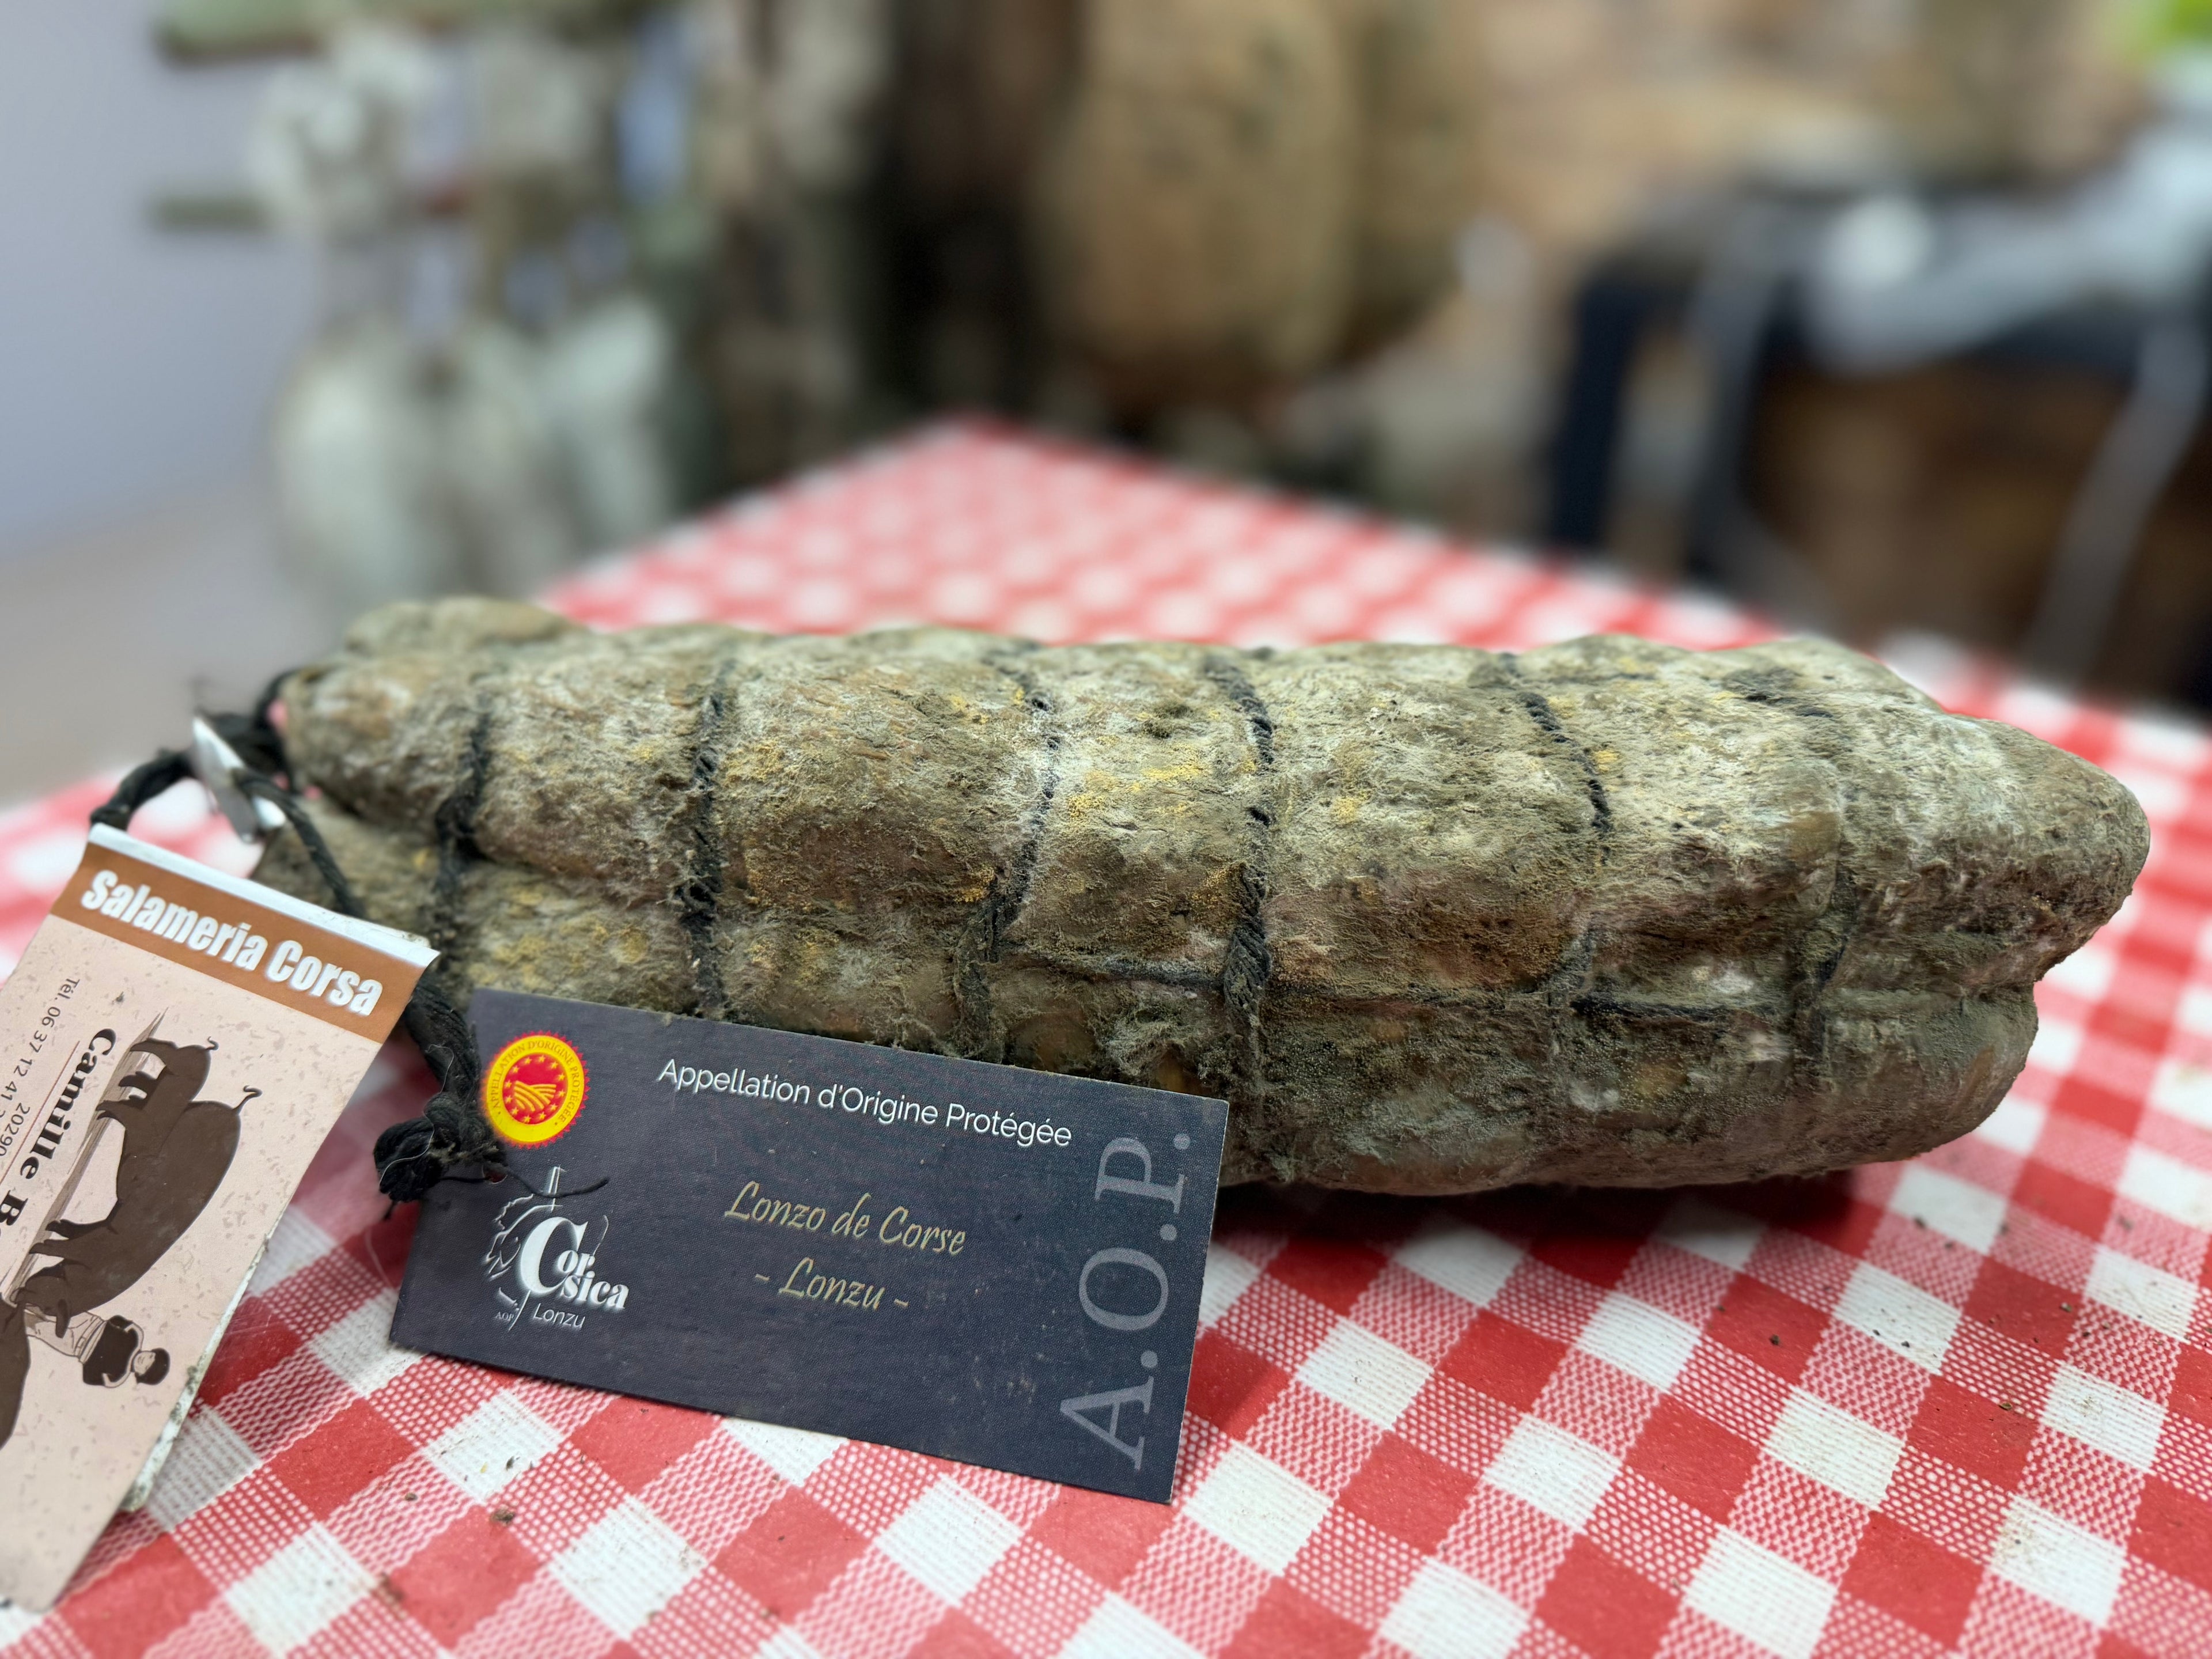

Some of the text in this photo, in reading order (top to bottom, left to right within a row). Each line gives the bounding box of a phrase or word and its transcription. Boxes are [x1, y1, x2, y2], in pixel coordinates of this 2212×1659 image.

[80, 869, 383, 1016] Salameria Corsa
[1, 978, 80, 1100] Tél. 06 37 12 41
[491, 1044, 525, 1109] APPELLATION
[528, 1040, 574, 1065] D'ORIGINE
[0, 1028, 116, 1237] Camille B
[657, 1059, 1071, 1147] Appellation d'Origine Protégée
[724, 1181, 966, 1255] Lonzo de Corse
[495, 1311, 514, 1321] AOP
[533, 1303, 586, 1328] Lonzu
[779, 1256, 885, 1310] Lonzu
[1060, 1132, 1191, 1471] A.O.P.
